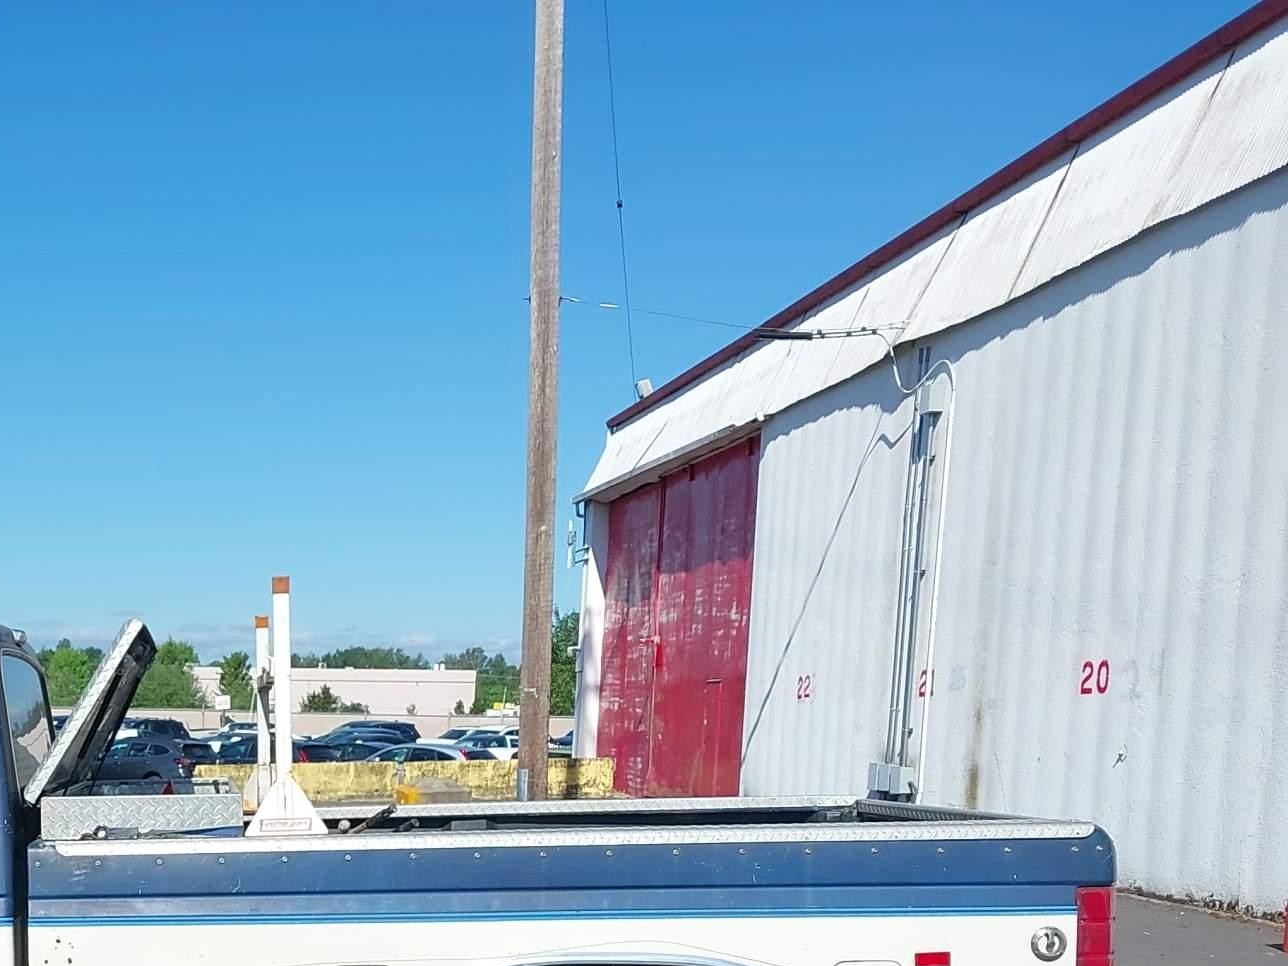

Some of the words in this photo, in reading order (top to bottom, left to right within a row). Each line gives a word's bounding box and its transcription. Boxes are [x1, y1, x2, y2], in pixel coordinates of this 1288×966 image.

[797, 675, 811, 699] 22
[918, 669, 935, 697] 21
[1080, 659, 1109, 695] 20
